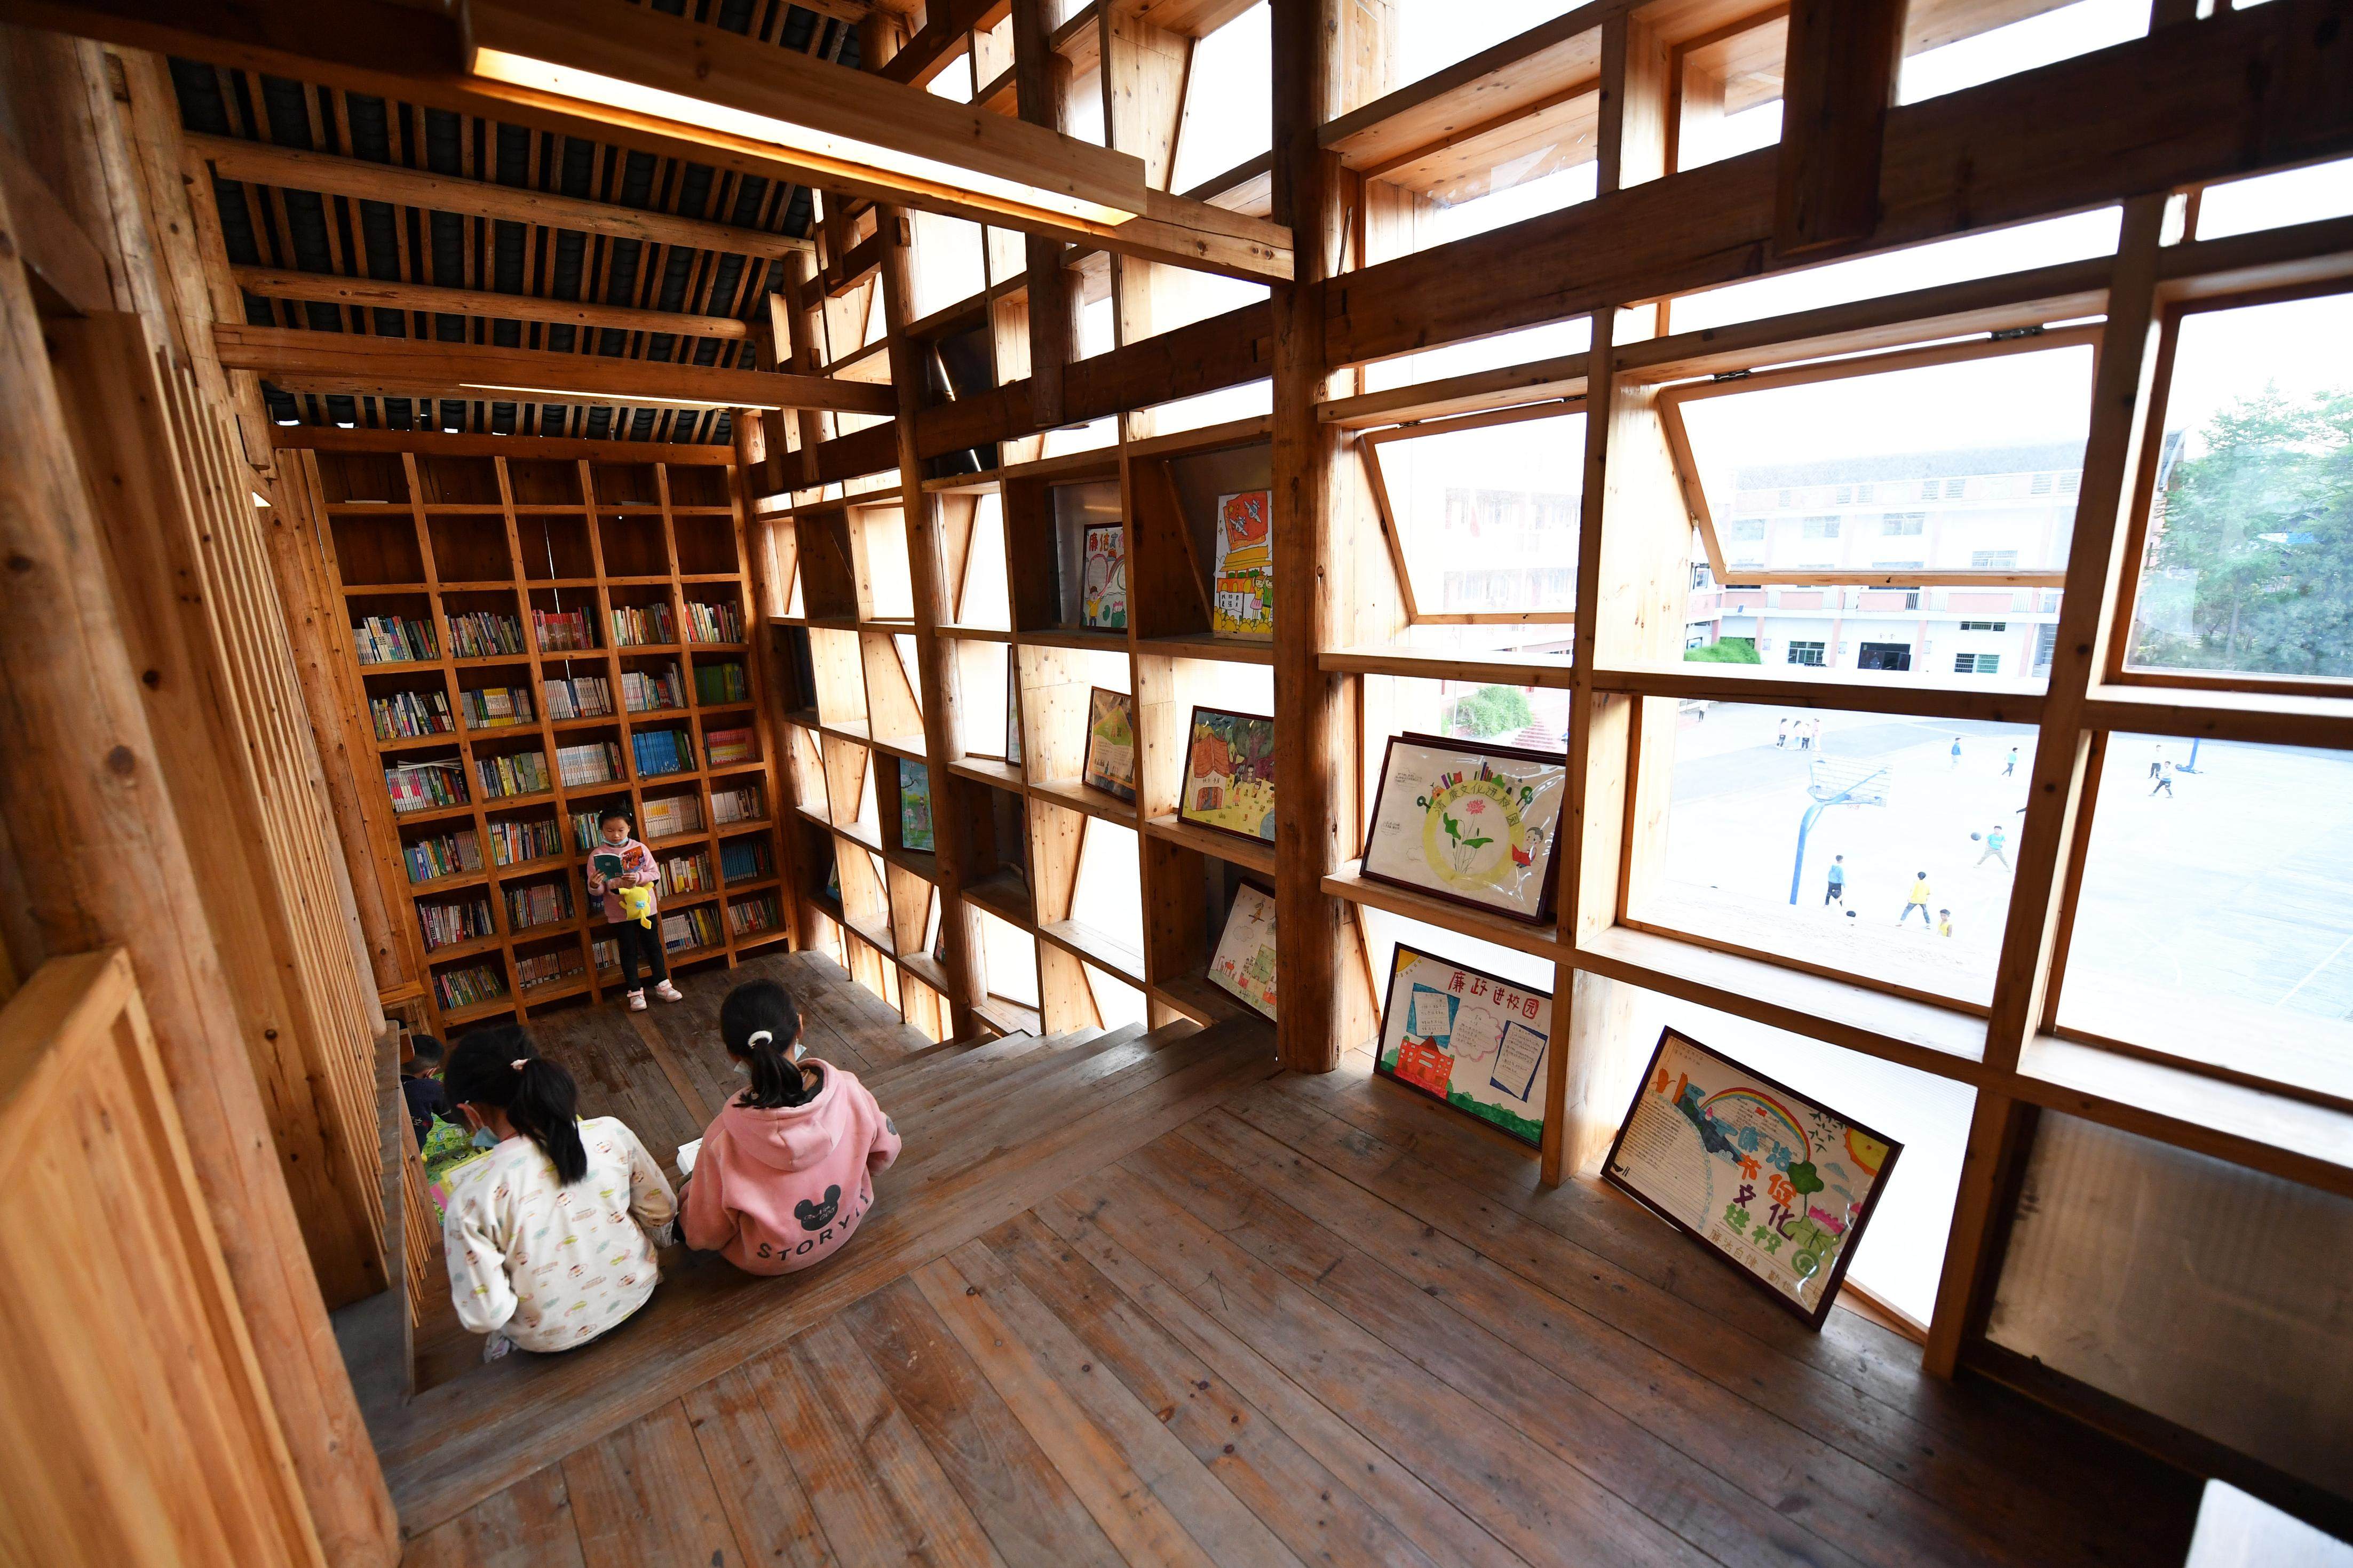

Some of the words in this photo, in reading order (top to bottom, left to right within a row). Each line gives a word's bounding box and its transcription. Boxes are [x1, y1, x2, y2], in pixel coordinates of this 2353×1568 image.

[1447, 971, 1539, 1020] 廉政进校园
[1733, 1184, 1795, 1241] 文化
[1707, 1229, 1759, 1269] 廉洁自律
